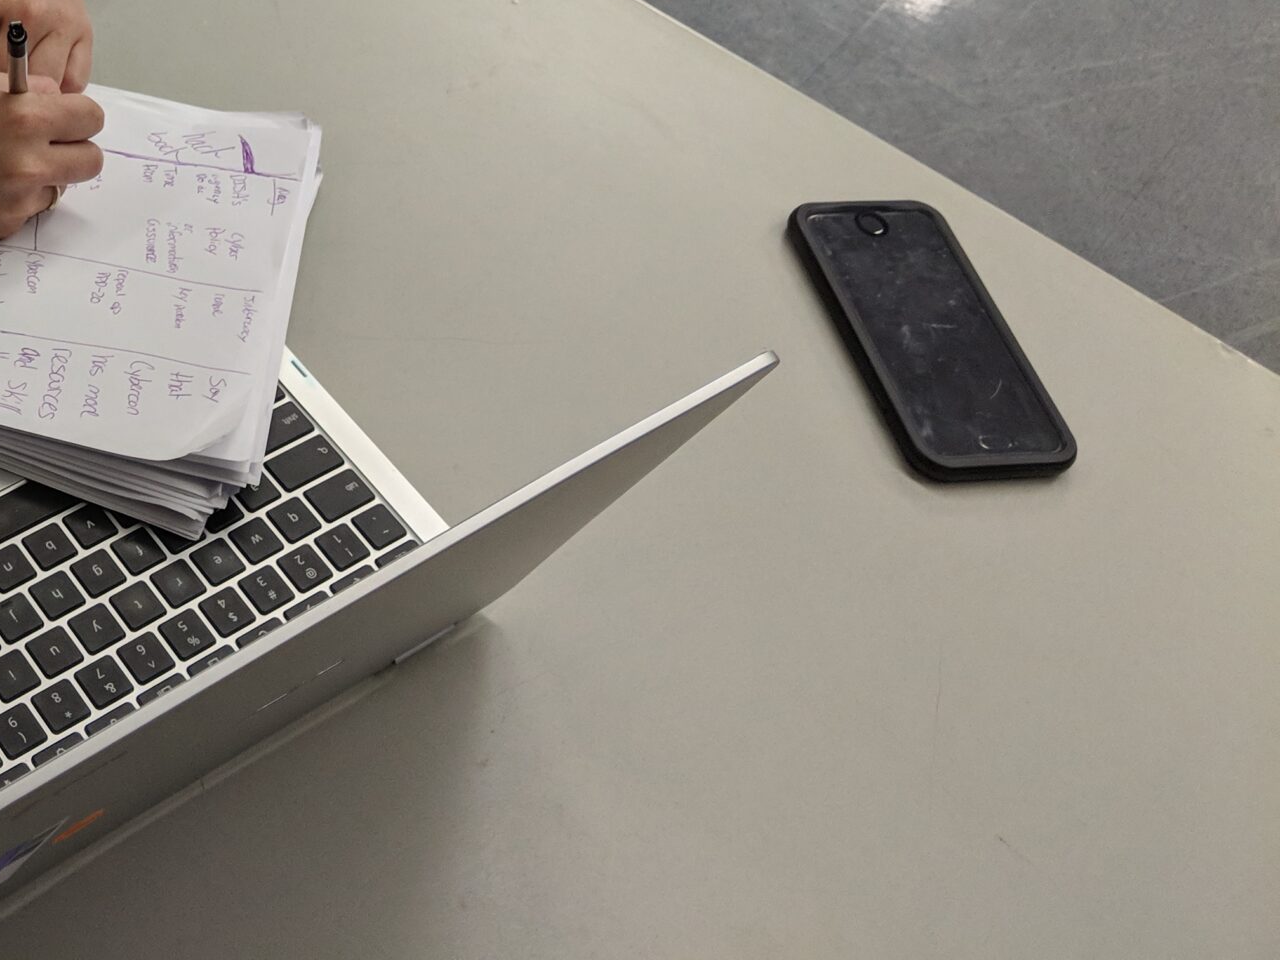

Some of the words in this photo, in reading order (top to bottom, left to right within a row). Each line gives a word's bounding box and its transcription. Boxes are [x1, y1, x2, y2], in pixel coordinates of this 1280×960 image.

[14, 348, 40, 369] and
[90, 355, 114, 376] has
[38, 349, 72, 420] resources
[169, 372, 193, 400] that
